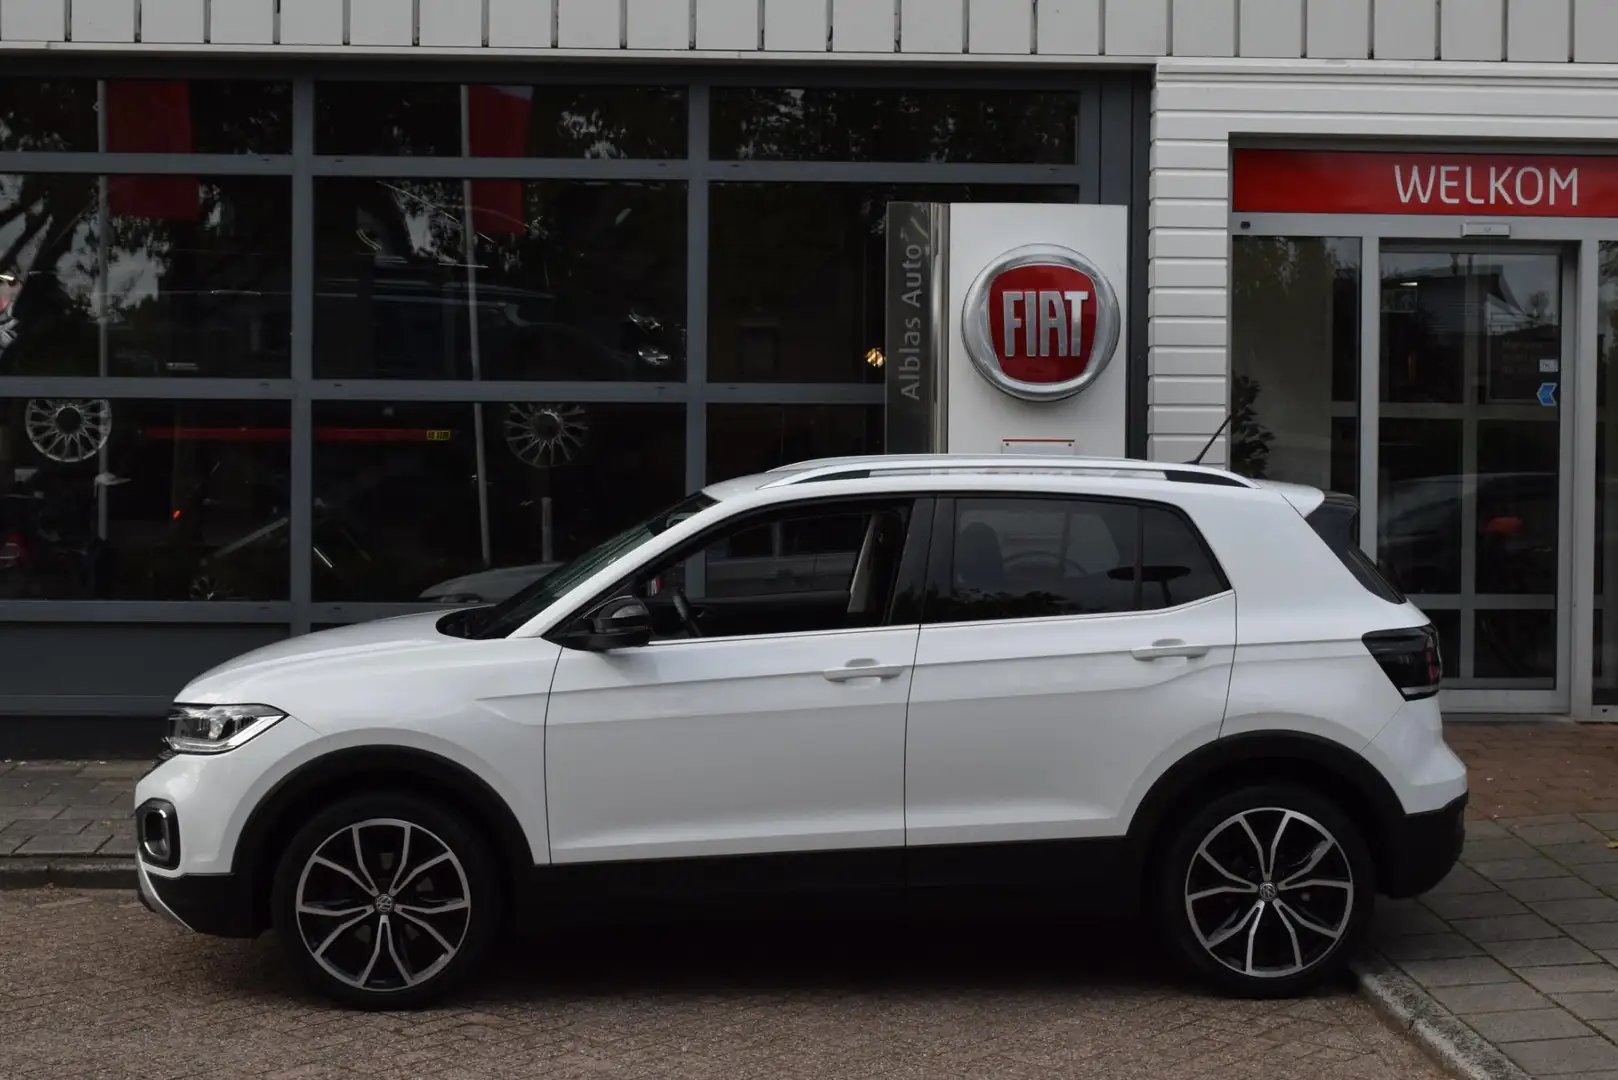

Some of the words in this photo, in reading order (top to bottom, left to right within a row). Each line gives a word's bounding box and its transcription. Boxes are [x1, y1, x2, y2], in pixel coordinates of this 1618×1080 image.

[1394, 164, 1579, 206] WELKOM
[901, 243, 923, 307] Auto
[1002, 290, 1089, 357] FIAT
[898, 316, 922, 400] Alblas
